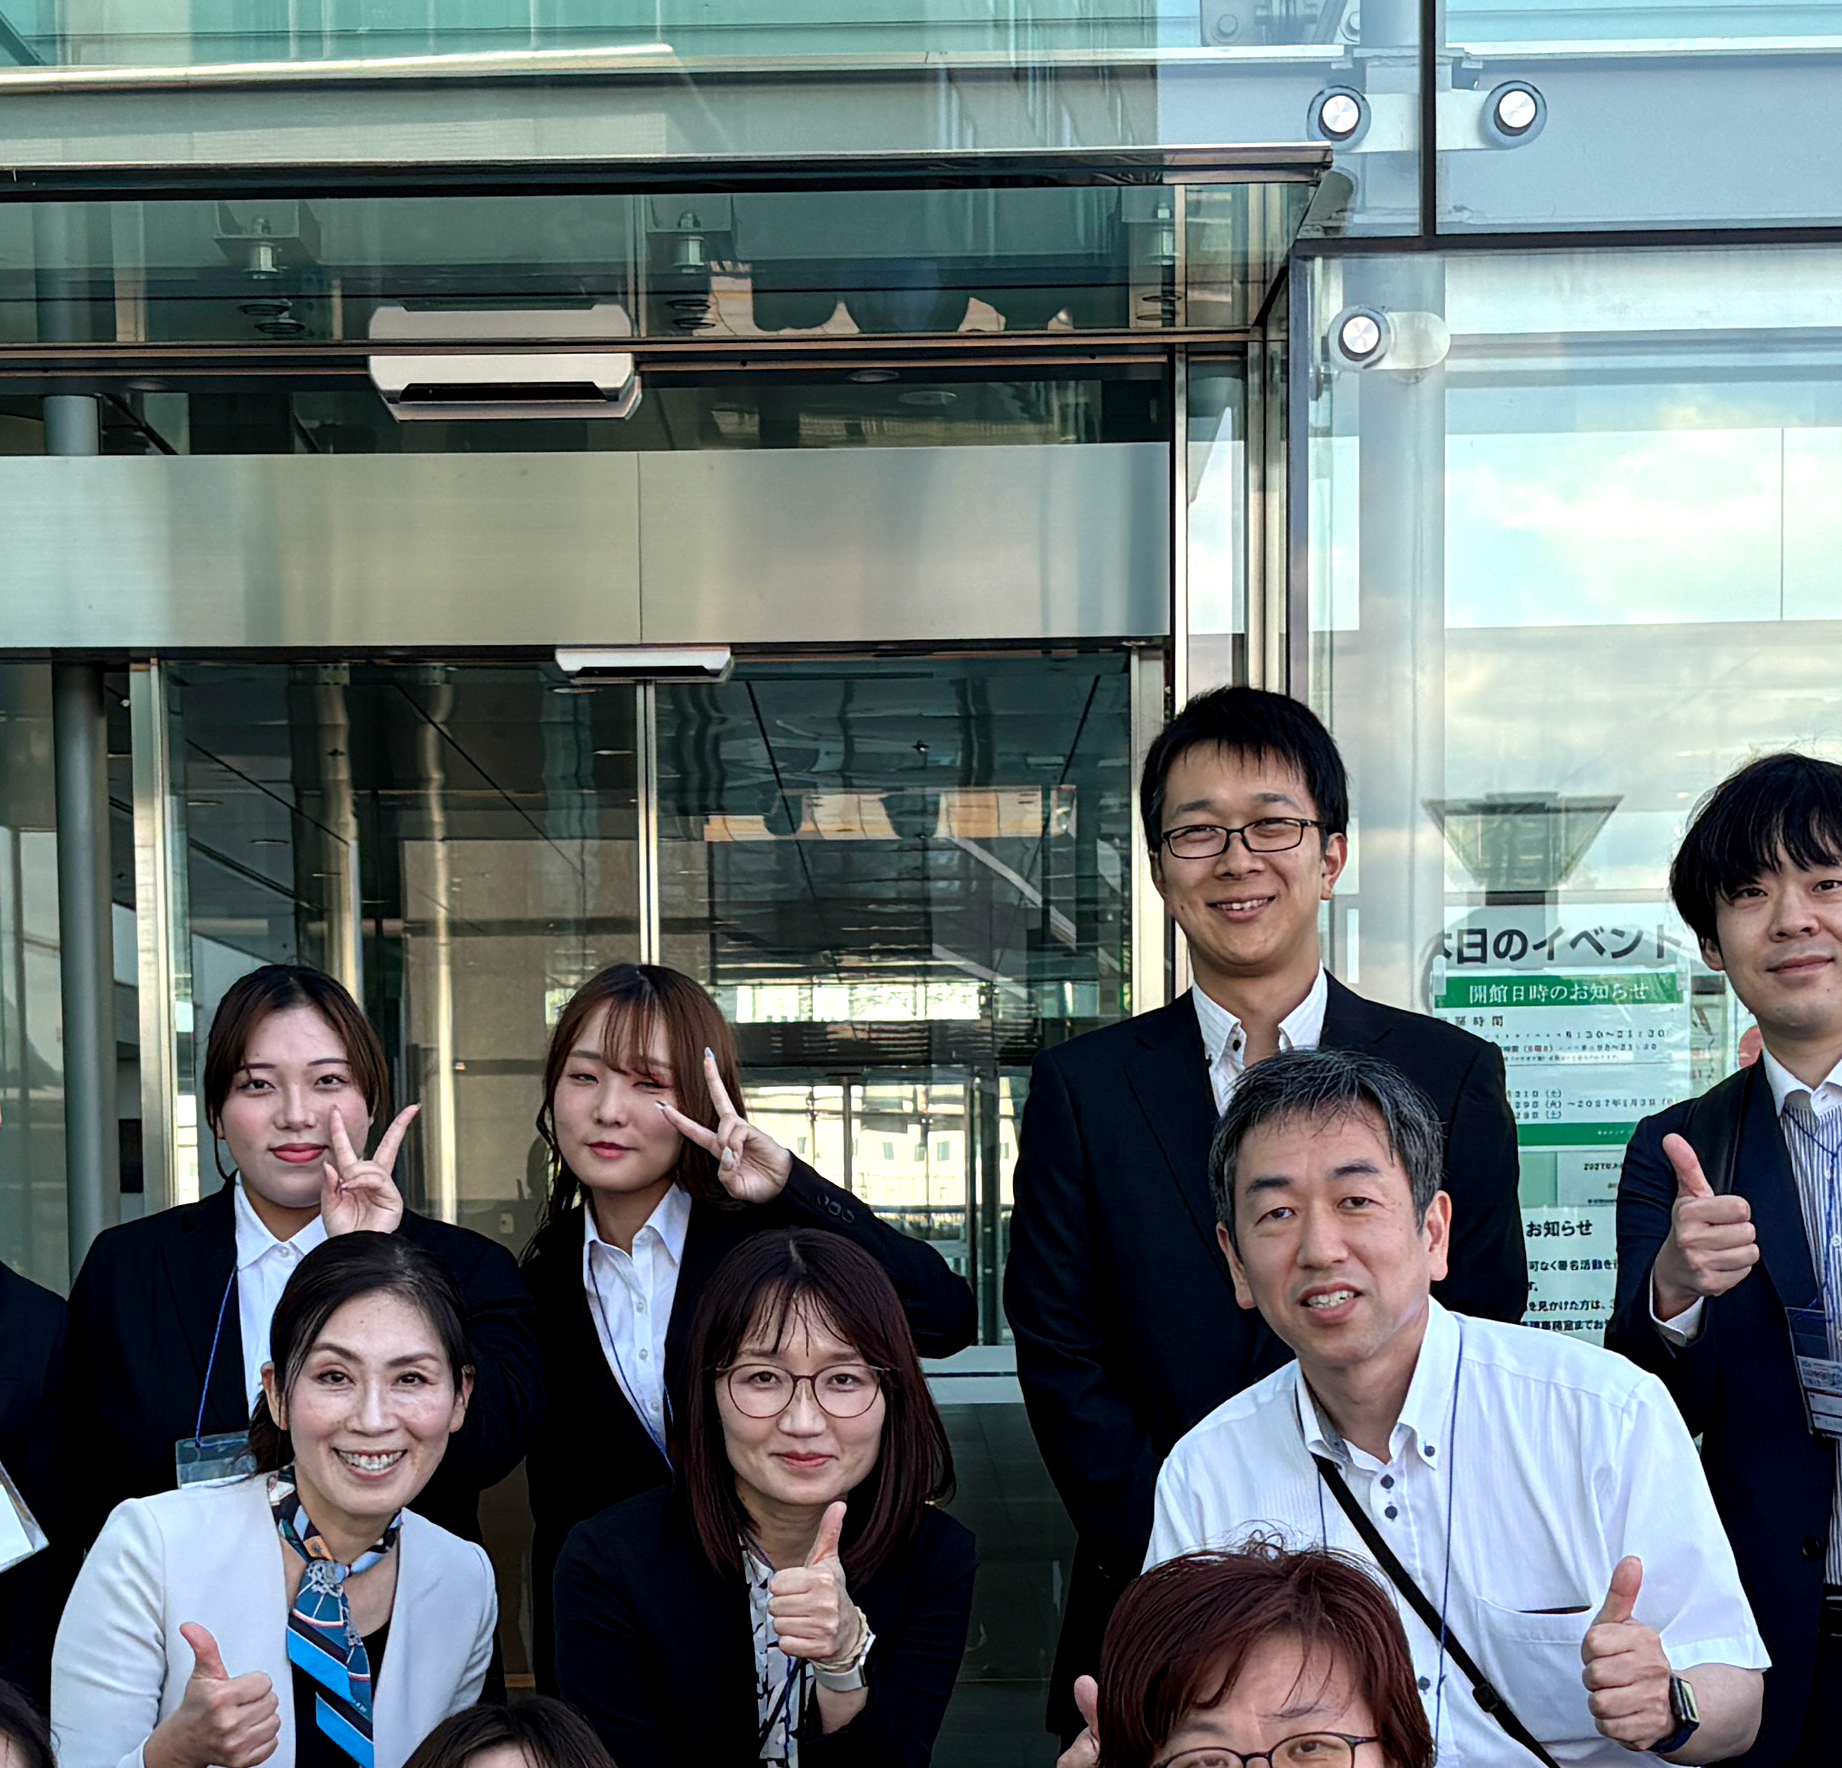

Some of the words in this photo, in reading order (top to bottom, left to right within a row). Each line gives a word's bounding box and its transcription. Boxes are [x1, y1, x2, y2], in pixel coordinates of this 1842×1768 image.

[1444, 924, 1682, 964] 日のイベント
[1469, 982, 1650, 1004] 開館日時のお知らせ
[1525, 1219, 1593, 1238] お知らせ
